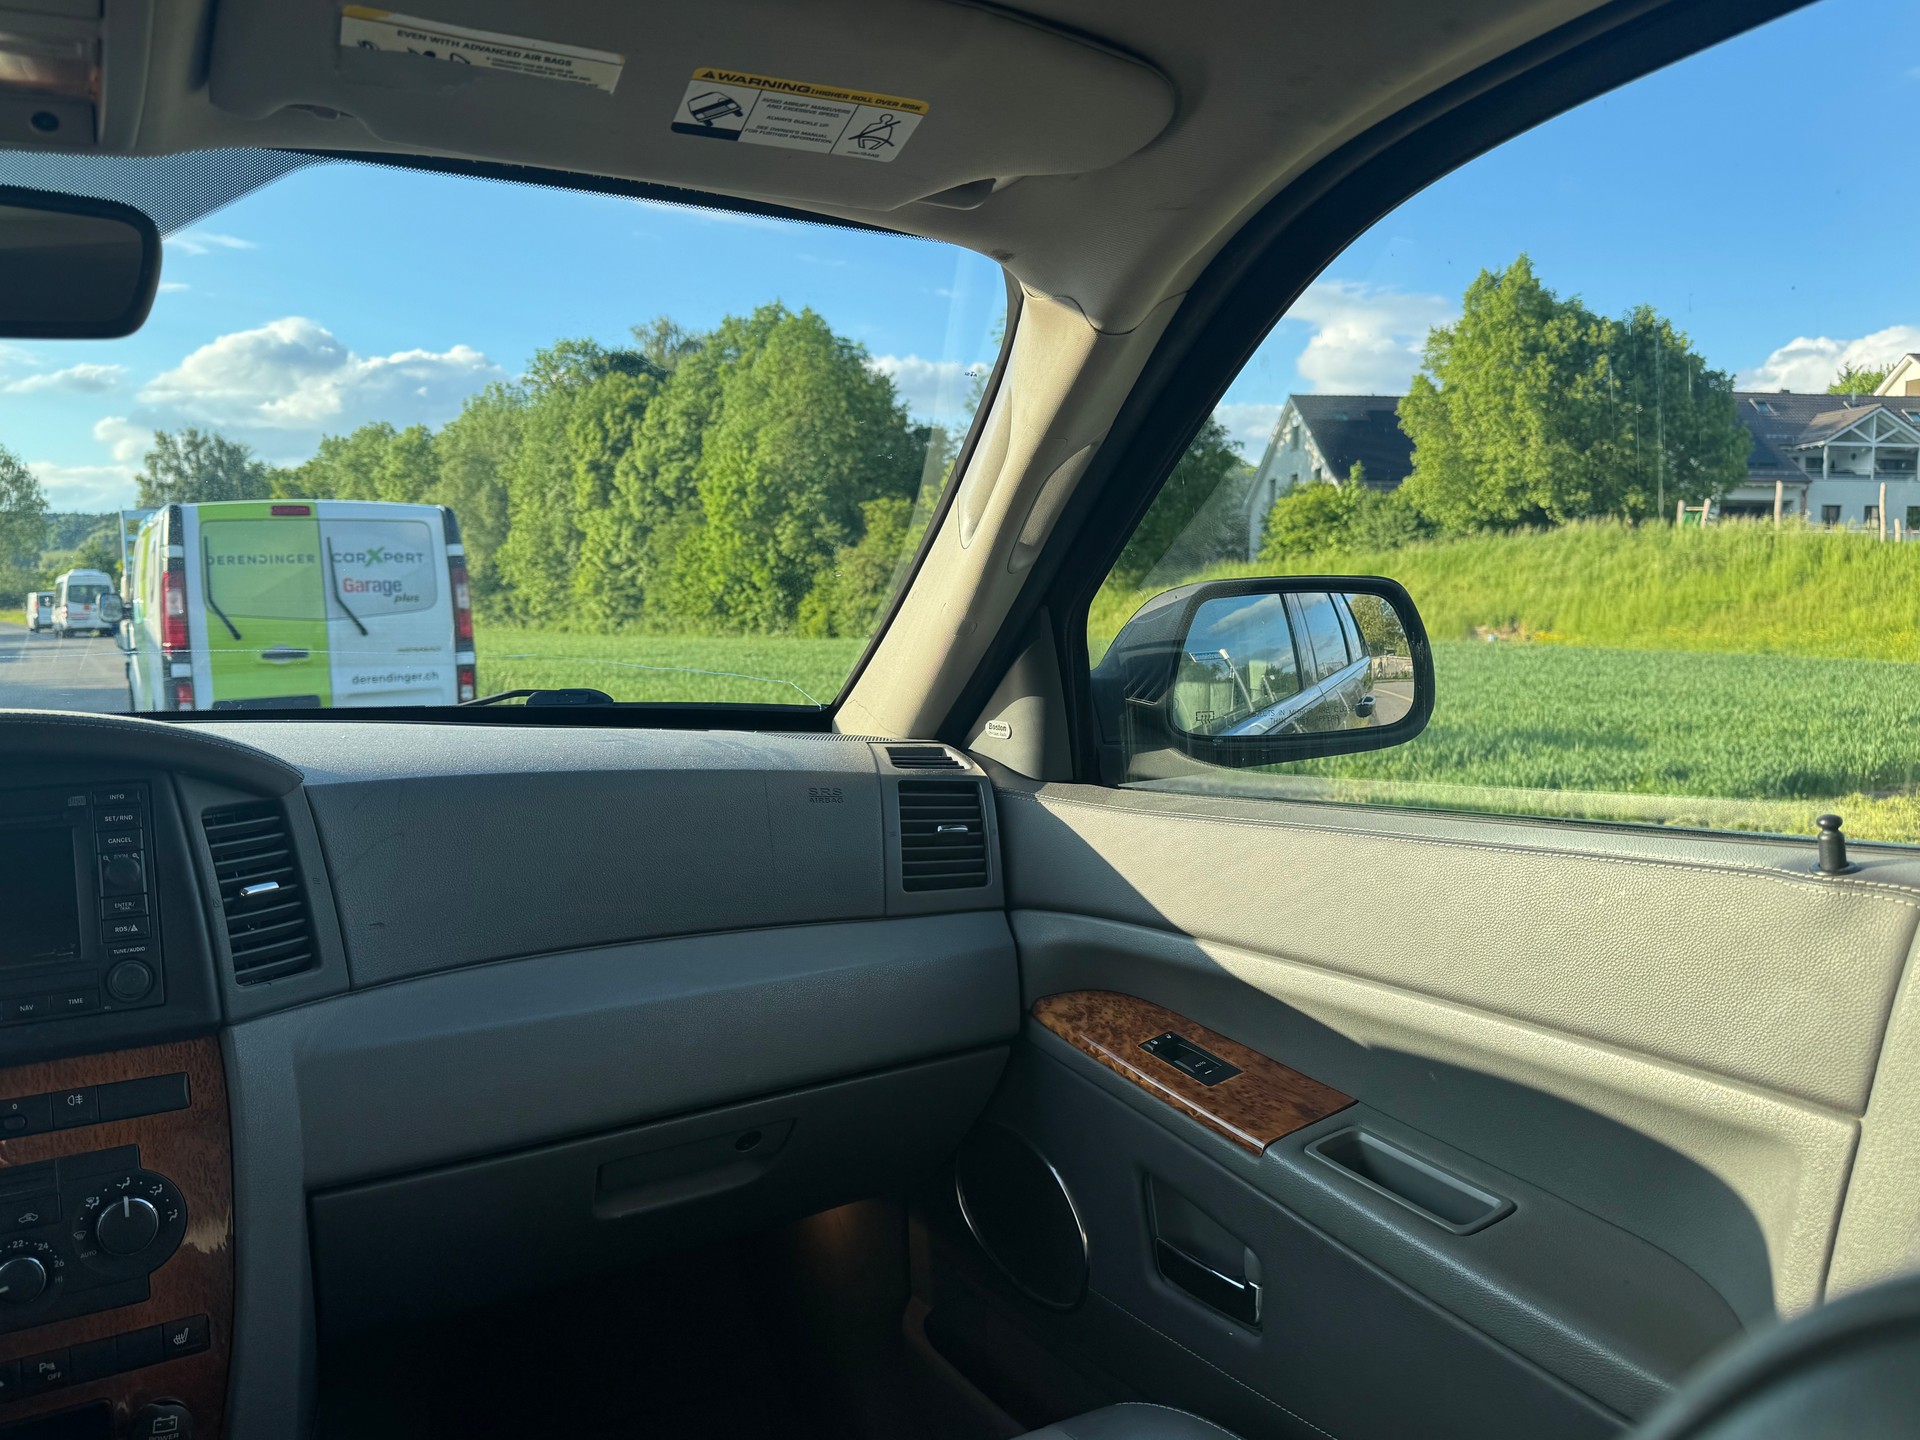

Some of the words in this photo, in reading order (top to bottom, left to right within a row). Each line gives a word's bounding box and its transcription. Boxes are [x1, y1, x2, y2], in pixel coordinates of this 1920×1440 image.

[397, 30, 427, 42] EVEN
[430, 36, 460, 48] WITH
[462, 42, 521, 58] ADVANCED
[523, 53, 542, 62] AIR
[544, 55, 573, 66] BAGS
[761, 97, 783, 105] AVOID
[815, 89, 850, 99] HIGHER
[850, 95, 874, 103] ROLL
[875, 98, 900, 107] OVER
[900, 102, 922, 111] RISK
[766, 115, 793, 123] ALWAYS
[793, 119, 819, 127] BUCKLE
[758, 129, 789, 138] FURTHER
[207, 553, 316, 566] DERENDINGER
[343, 577, 403, 597] Garage
[393, 593, 420, 604] plus
[351, 671, 440, 685] derendinger.ch
[988, 722, 1007, 732] Boston
[808, 787, 843, 796] SRS
[104, 814, 133, 822] SET/RND
[113, 946, 146, 955] TUNE/AUDIO
[68, 997, 84, 1005] TIME
[19, 1004, 34, 1012] NAV
[12, 1240, 24, 1249] 22
[37, 1242, 49, 1251] 24
[80, 1249, 97, 1259] AUTO
[54, 1259, 65, 1268] 26
[55, 1275, 63, 1283] HI
[47, 1371, 62, 1381] OFF
